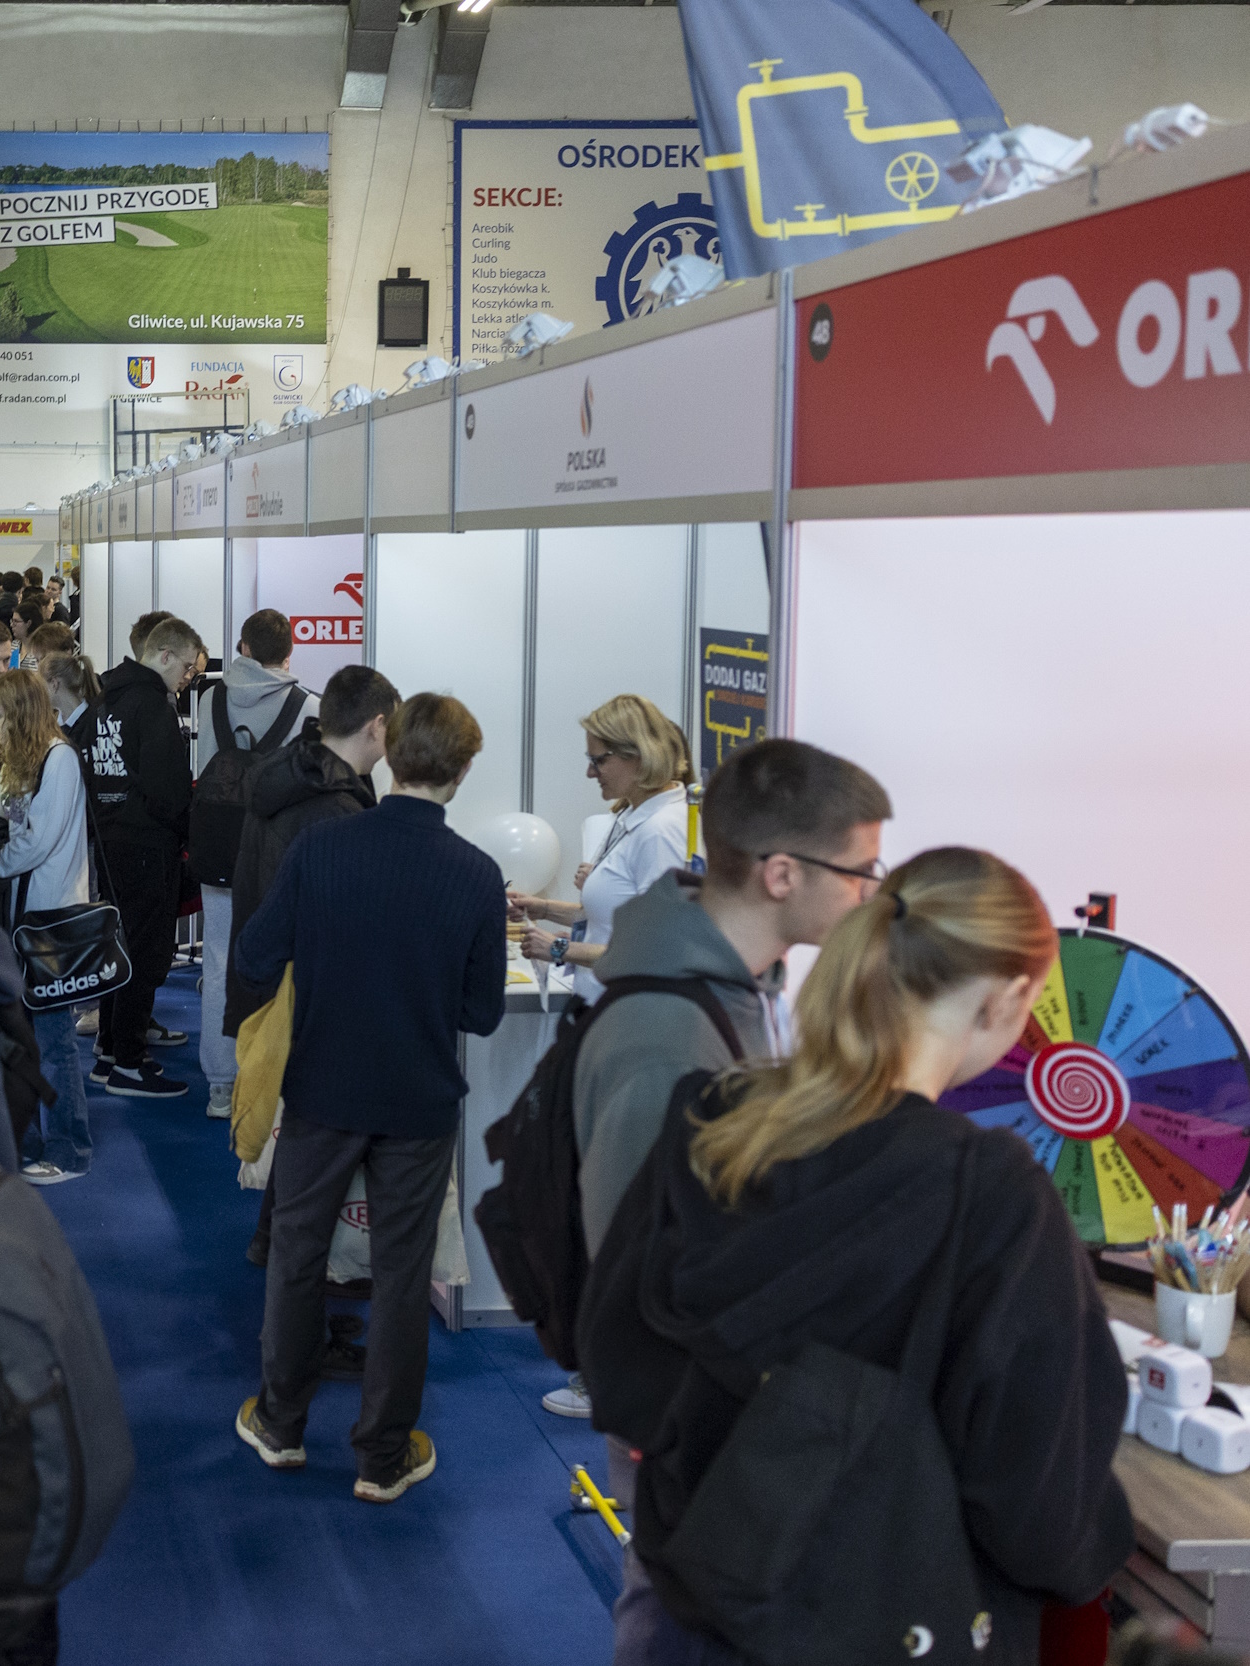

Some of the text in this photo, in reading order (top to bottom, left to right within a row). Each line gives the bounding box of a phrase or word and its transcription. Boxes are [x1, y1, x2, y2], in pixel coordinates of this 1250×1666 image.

[557, 138, 701, 168] OŚRODEK
[97, 187, 209, 210] PRZYGODĘ
[472, 187, 563, 207] SEKCJE:
[0, 221, 103, 244] Z GOLFEM
[472, 222, 515, 234] Areobik
[472, 237, 511, 251] Curling
[471, 253, 498, 264] Judo
[472, 268, 546, 281] Klub biegacza
[472, 283, 550, 296] Koszykówka k.
[472, 298, 554, 311] Koszykówka m.
[128, 314, 305, 331] Gliwice, ul. Kujawska 75
[472, 313, 528, 323] Lekka atle
[472, 328, 508, 338] Narcia
[1116, 267, 1250, 388] OR
[472, 343, 498, 353] Piłka
[15, 351, 33, 361] 051
[191, 361, 245, 373] FUNDACJA
[566, 447, 606, 472] POLSKA
[704, 663, 767, 694] DODAJ GAZ
[34, 973, 100, 998] adidas
